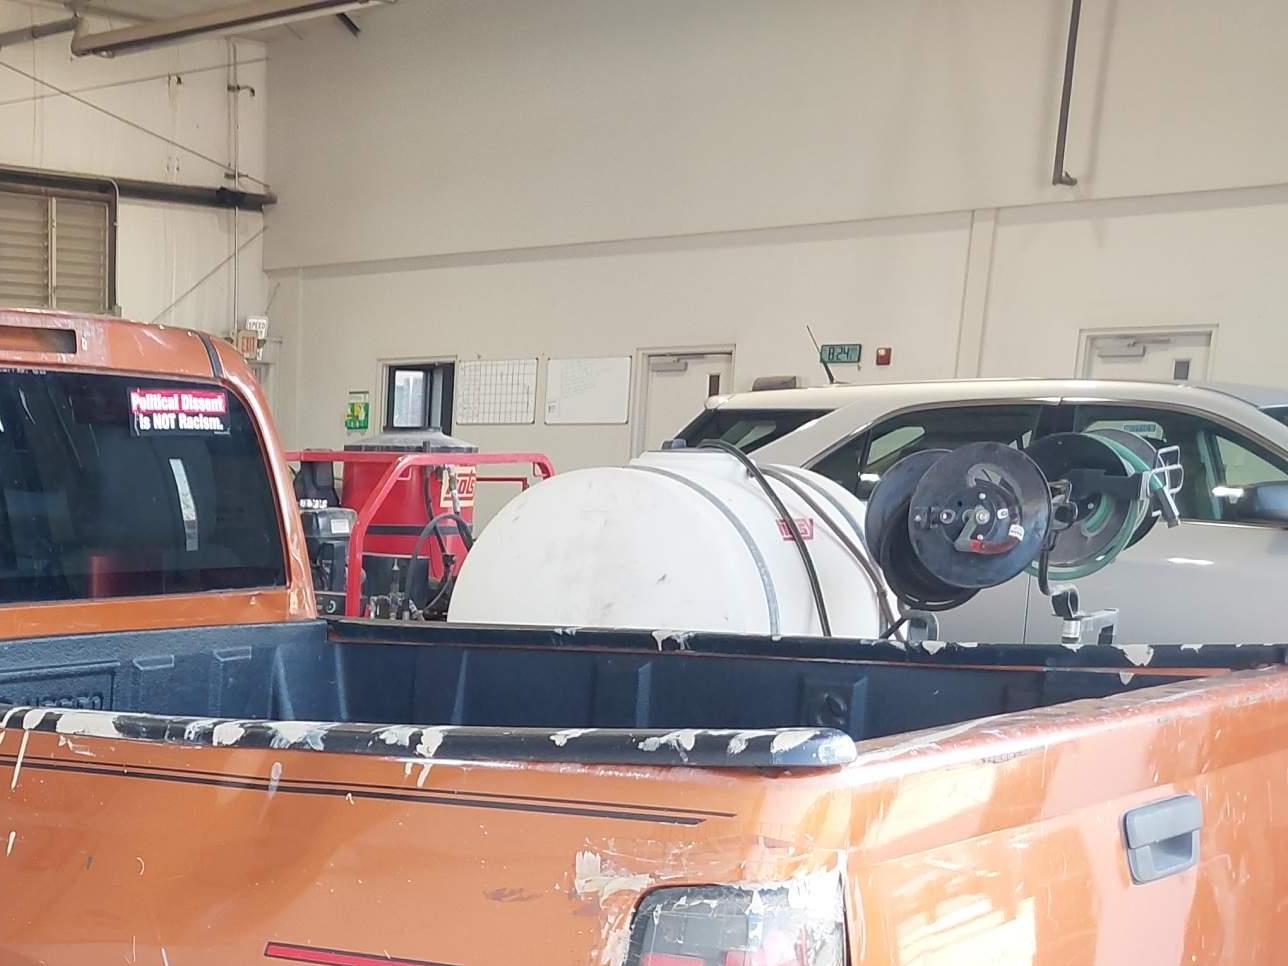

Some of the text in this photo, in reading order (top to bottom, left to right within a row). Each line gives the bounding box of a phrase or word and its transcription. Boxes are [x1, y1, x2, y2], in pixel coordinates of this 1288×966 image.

[131, 392, 226, 412] Political Dissent
[152, 412, 176, 430] NOT
[178, 413, 224, 430] Racism.
